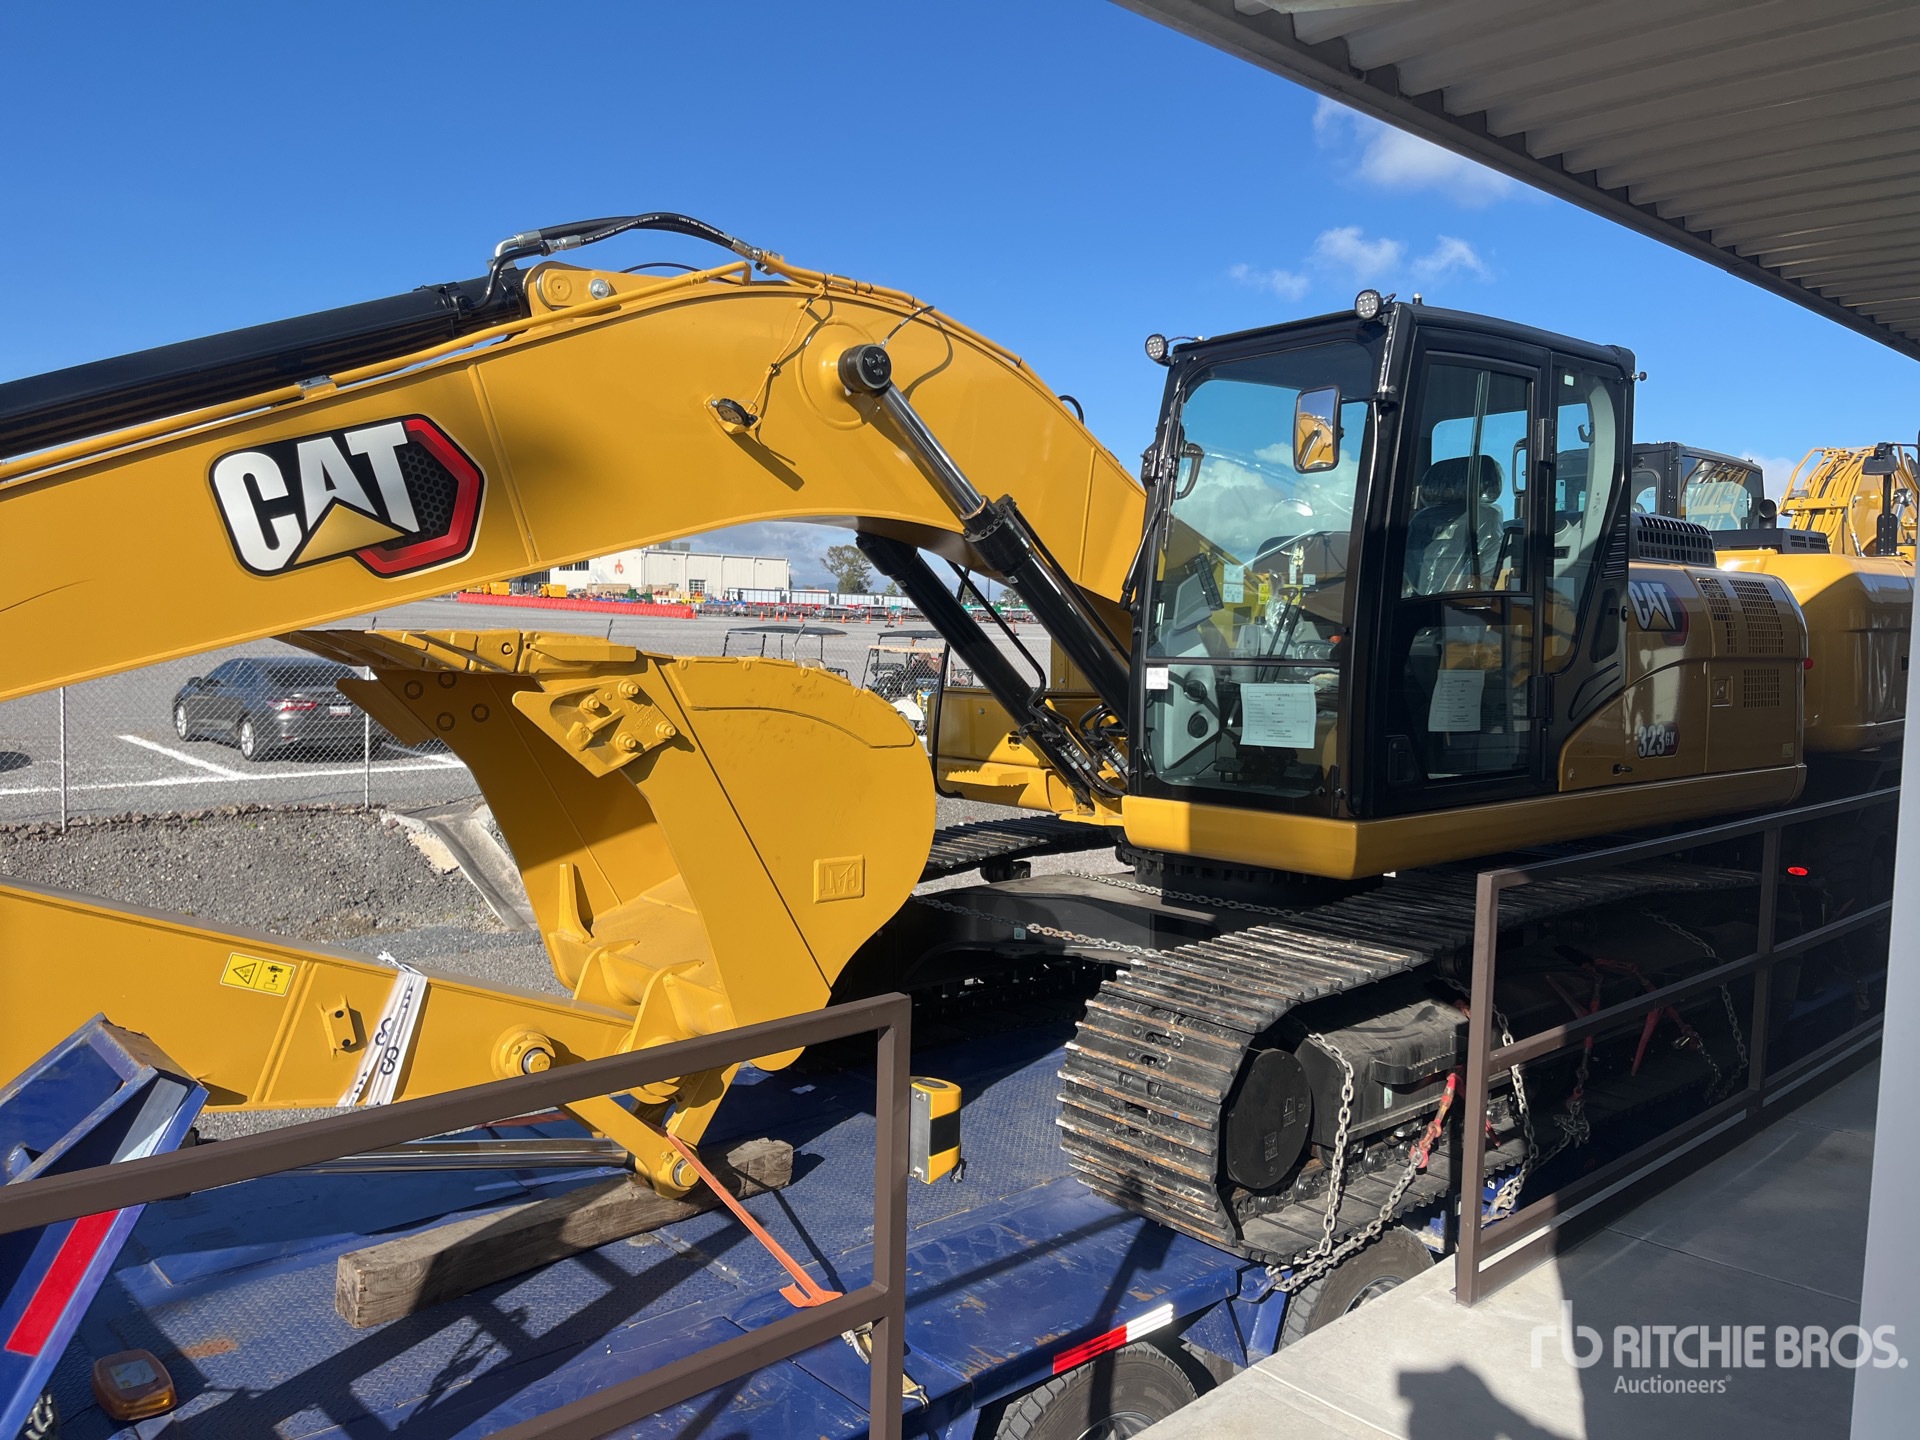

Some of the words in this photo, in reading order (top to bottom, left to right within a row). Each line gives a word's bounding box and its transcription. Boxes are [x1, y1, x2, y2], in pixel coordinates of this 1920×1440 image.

[214, 421, 420, 571] CAT
[1628, 581, 1676, 630] CAT
[820, 862, 862, 897] CAT
